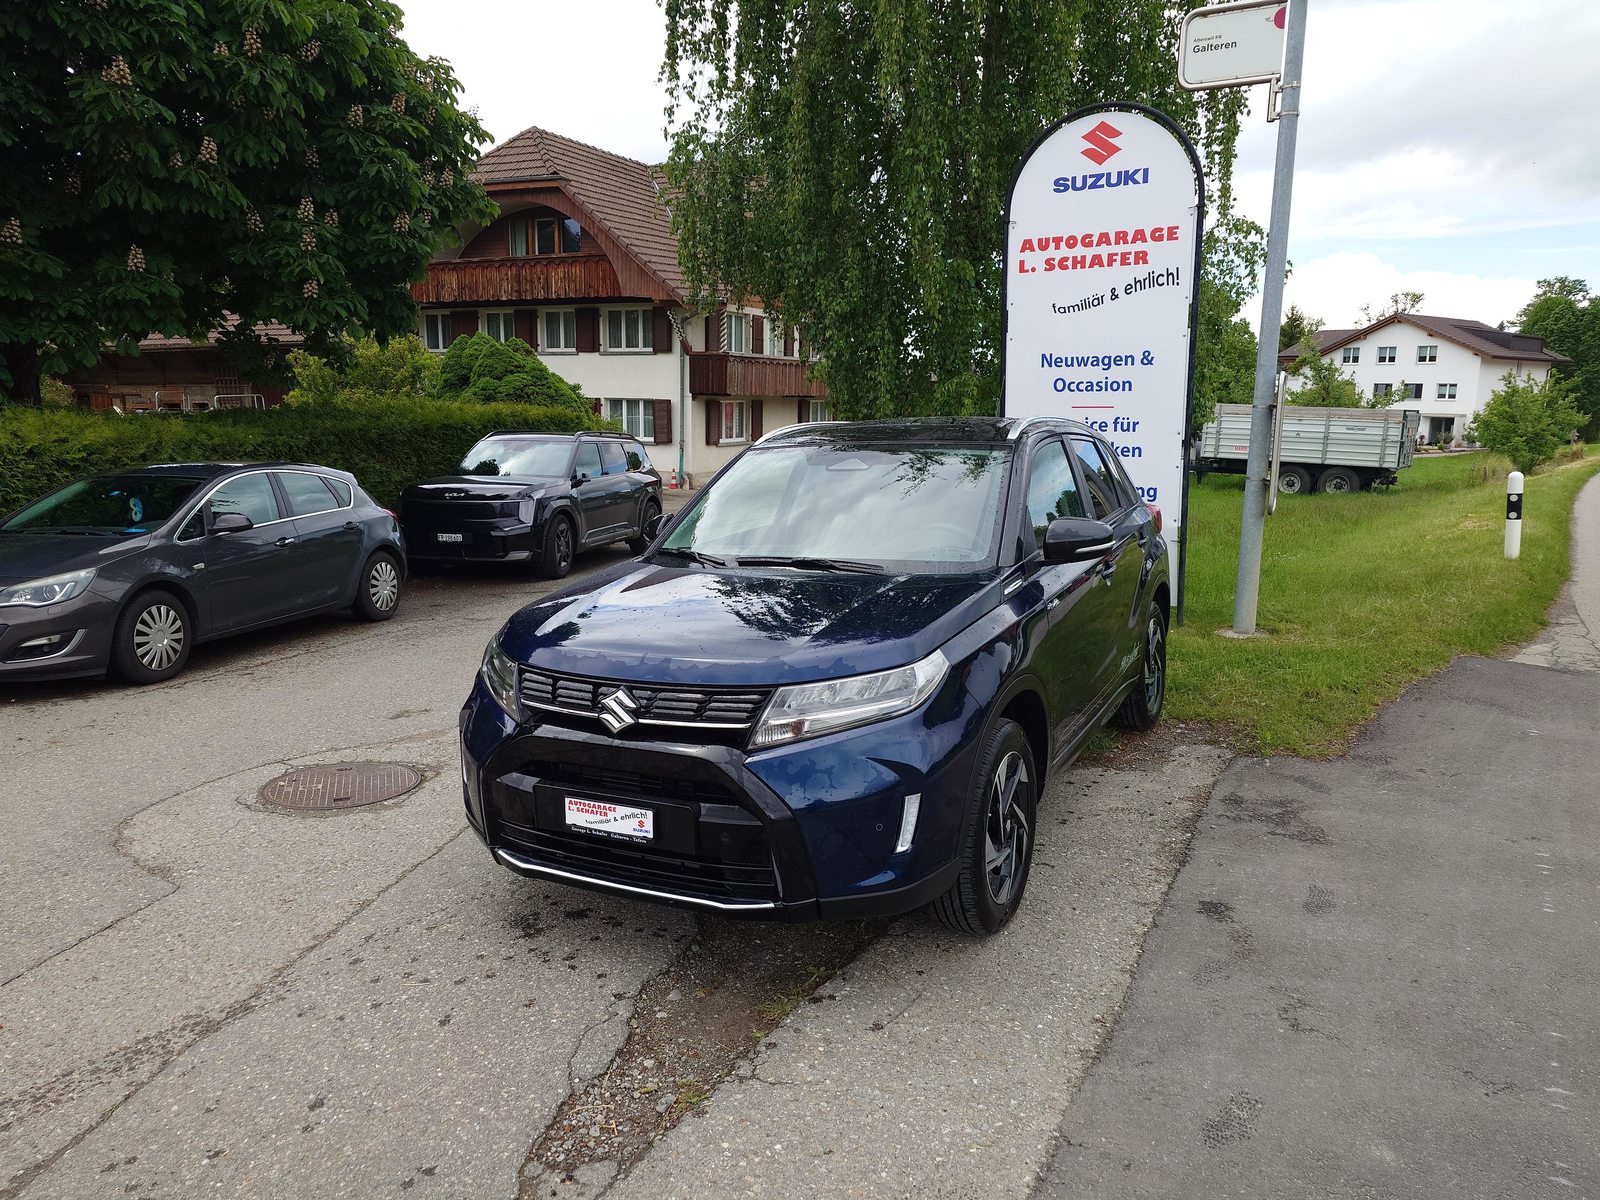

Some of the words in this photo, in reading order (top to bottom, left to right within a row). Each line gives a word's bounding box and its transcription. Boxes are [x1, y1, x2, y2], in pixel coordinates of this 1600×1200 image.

[1193, 41, 1237, 53] Galteren
[1052, 167, 1149, 194] SUZUKI
[1019, 225, 1180, 253] AUTOGARAGE
[1018, 259, 1037, 274] L.
[1044, 250, 1149, 272] SCHAFER
[1052, 293, 1105, 314] familiär
[1109, 287, 1120, 301] &
[1124, 267, 1180, 295] ehrlich!
[1041, 353, 1135, 371] Neuwagen
[1140, 350, 1154, 366] &
[1053, 377, 1132, 392] Occasion
[1112, 416, 1139, 433] für
[1110, 442, 1142, 458] ken
[568, 799, 617, 813] AUTOGARAGE
[576, 807, 608, 817] SCHAFER
[585, 817, 611, 825] familiär
[620, 811, 648, 821] ehrlich!
